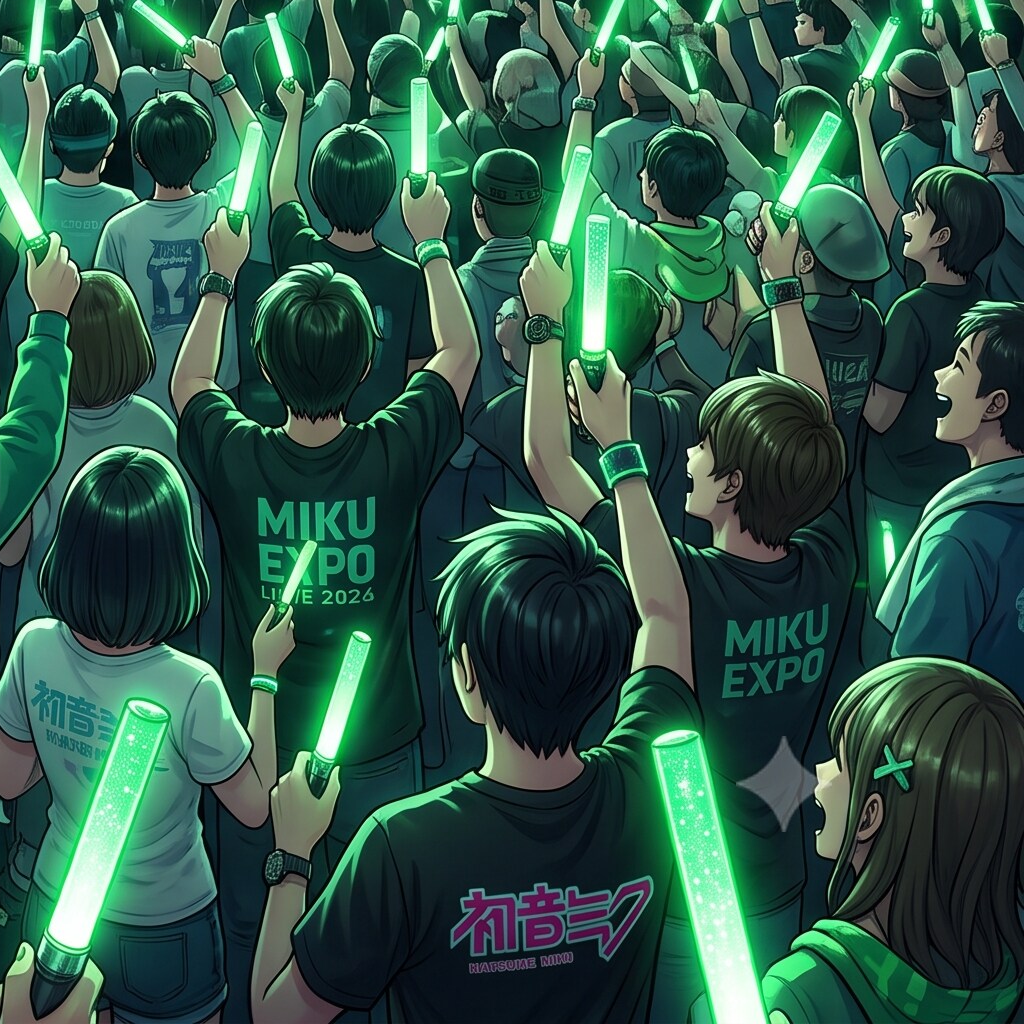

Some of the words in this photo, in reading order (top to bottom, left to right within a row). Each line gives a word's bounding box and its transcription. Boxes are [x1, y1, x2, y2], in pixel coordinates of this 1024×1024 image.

[257, 495, 376, 541] MIKU
[321, 586, 375, 605] 2026
[724, 603, 829, 657] MIKU
[721, 647, 825, 699] EXPO
[450, 874, 654, 963] 初音ミク
